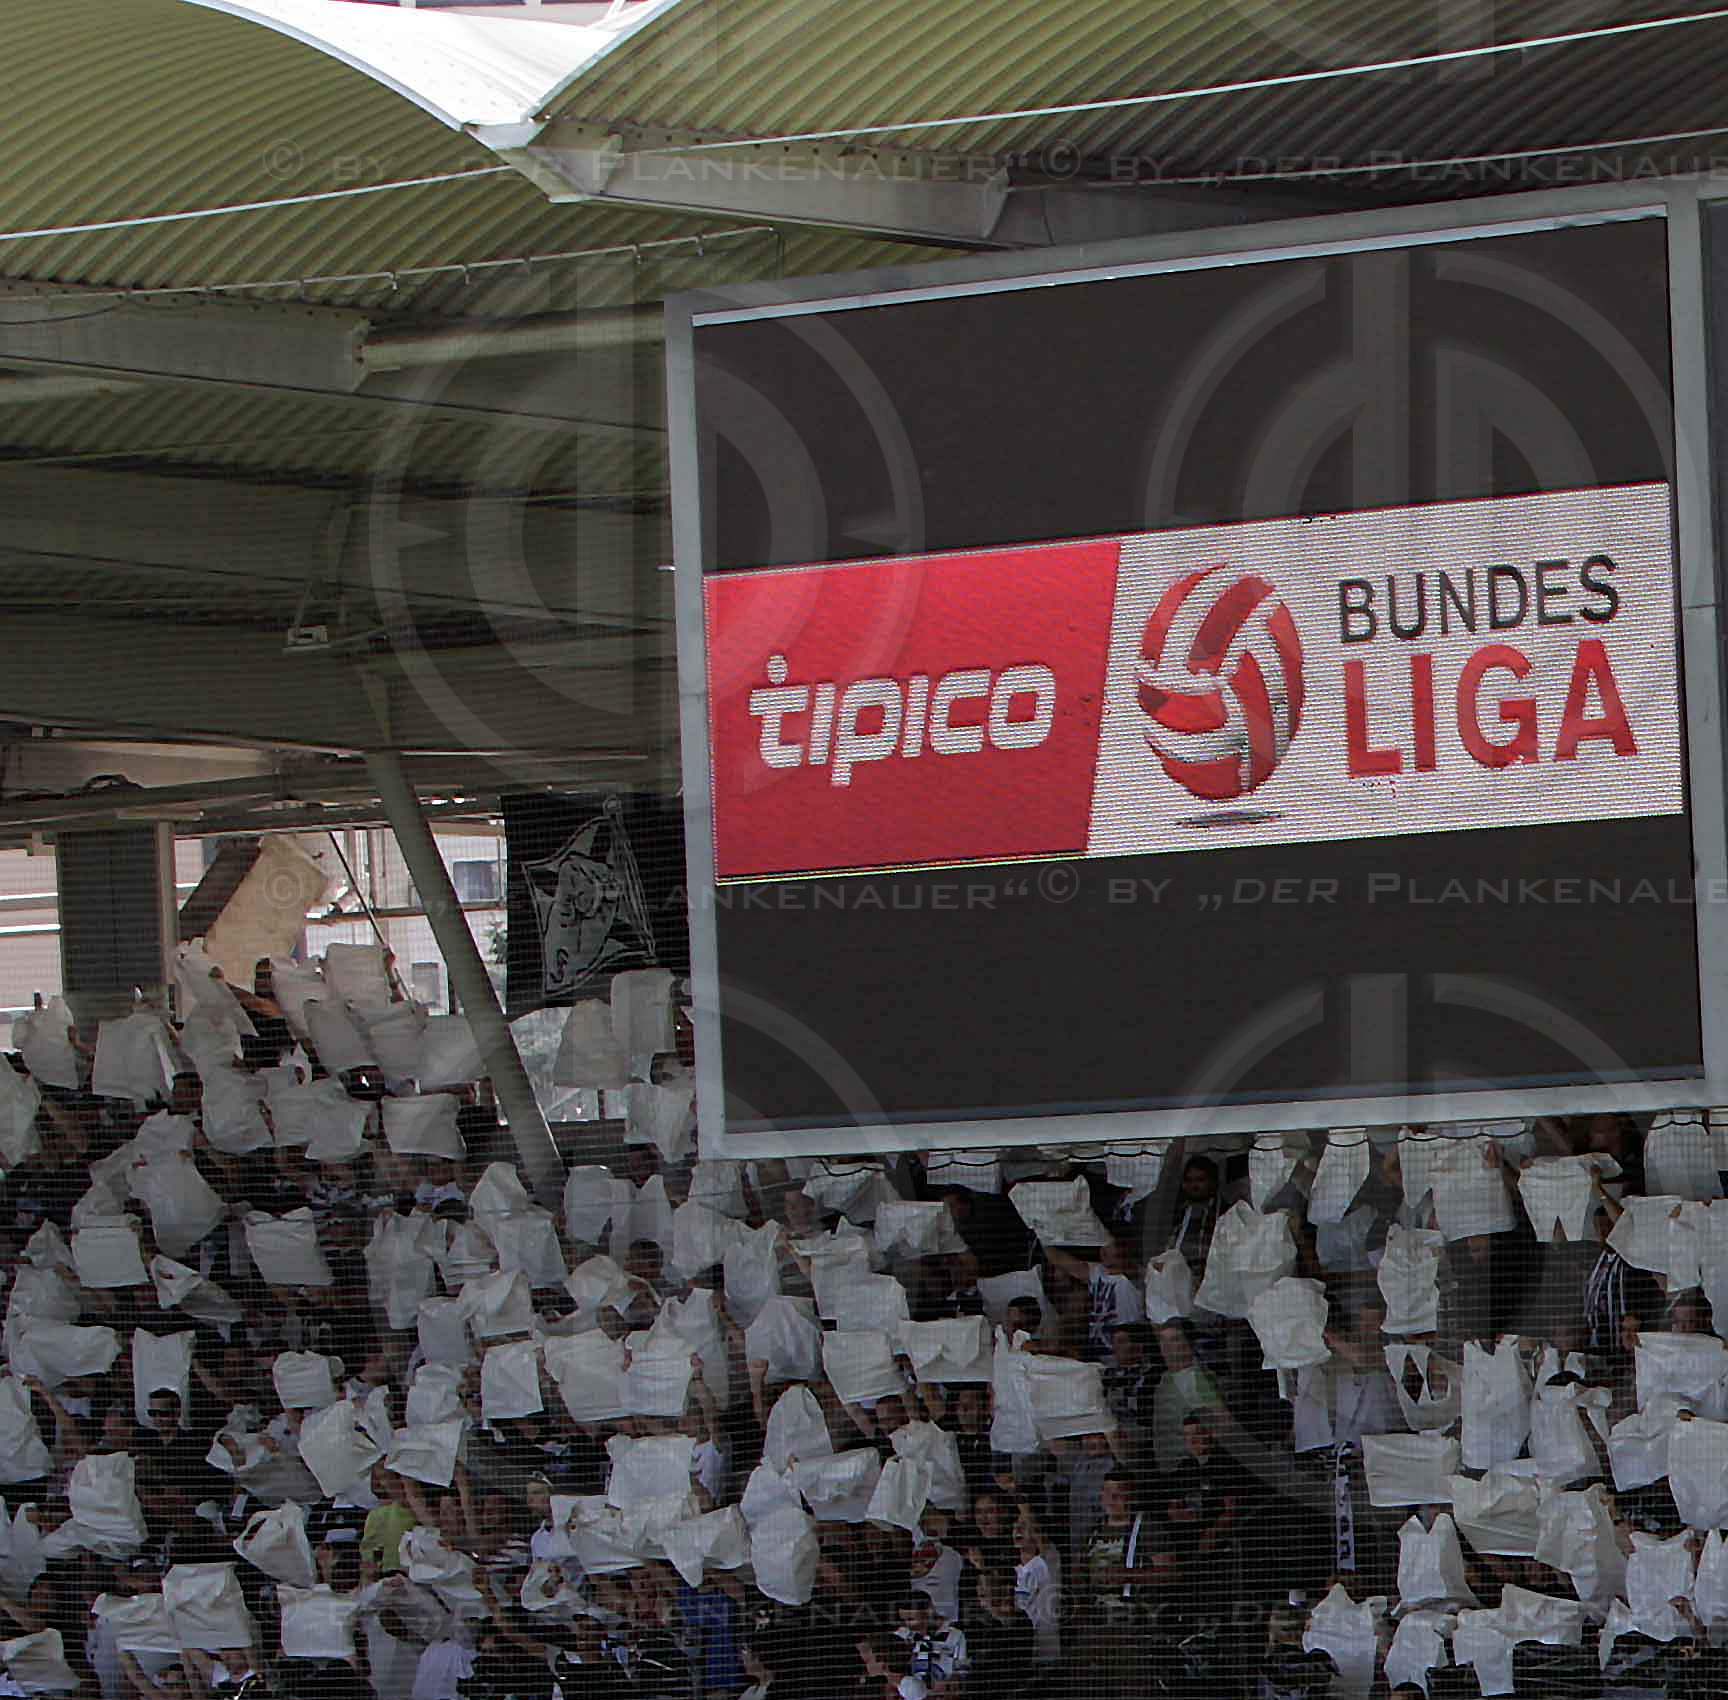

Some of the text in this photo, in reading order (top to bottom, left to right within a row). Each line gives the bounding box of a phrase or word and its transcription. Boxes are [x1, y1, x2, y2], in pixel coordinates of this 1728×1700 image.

[1338, 554, 1620, 645] BUNDES
[748, 654, 1057, 786] tipico
[1343, 637, 1639, 779] LIGA
